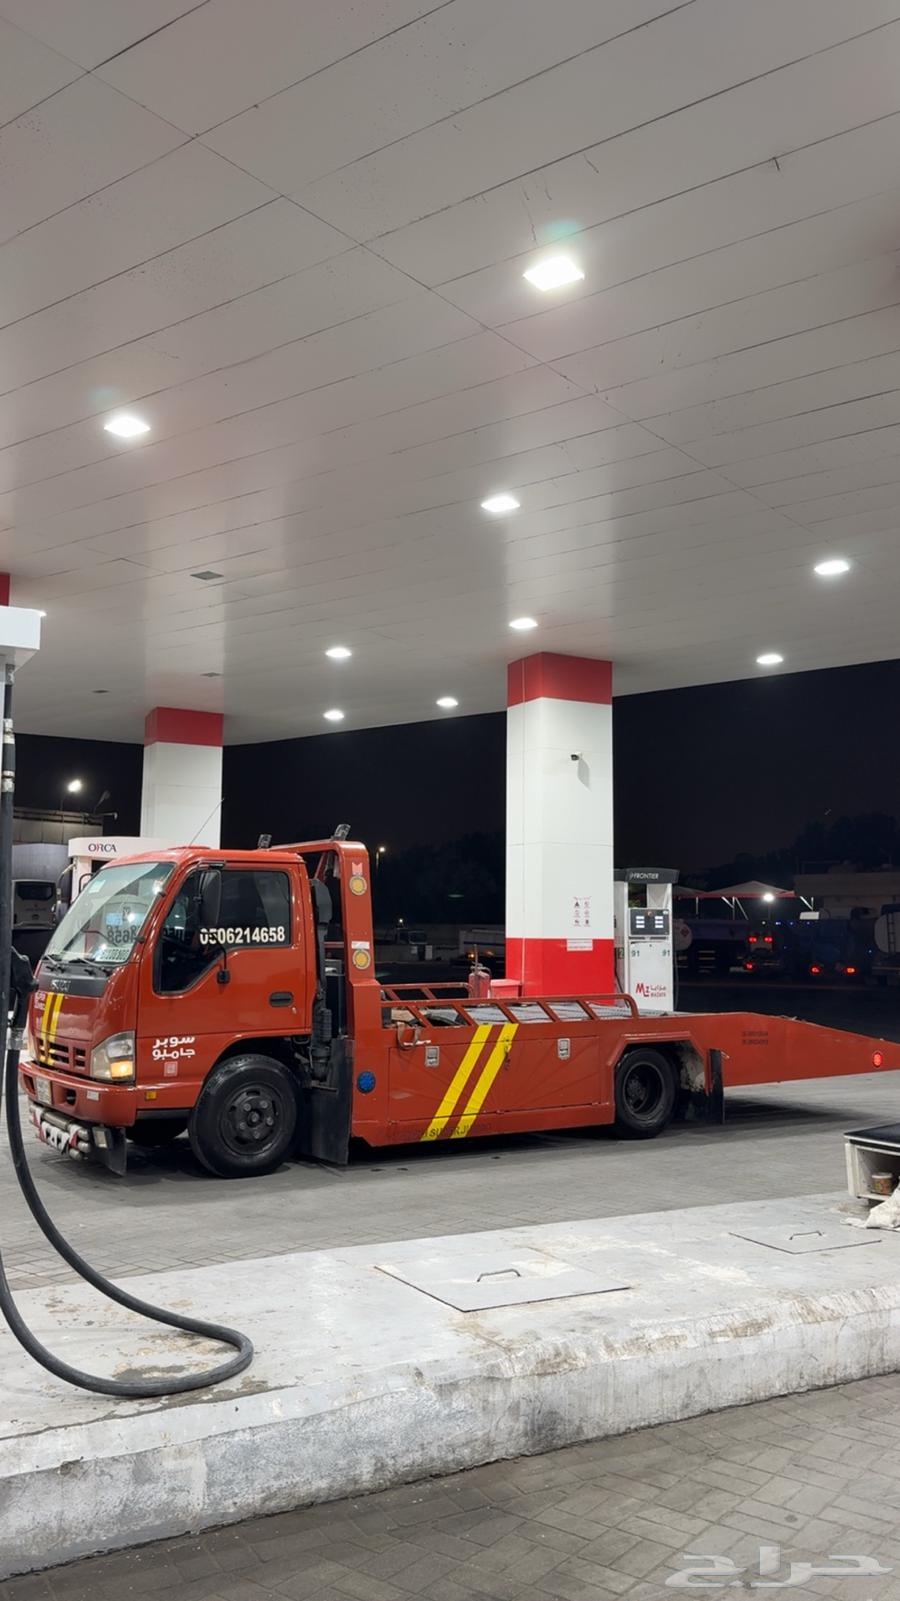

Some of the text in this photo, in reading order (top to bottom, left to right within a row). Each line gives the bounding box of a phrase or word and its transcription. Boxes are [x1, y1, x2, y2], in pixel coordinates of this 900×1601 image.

[88, 843, 117, 854] ORCA
[200, 927, 285, 945] 0506214658
[662, 949, 670, 957] 91
[152, 1036, 195, 1049] سوبر
[152, 1048, 195, 1061] جامبو
